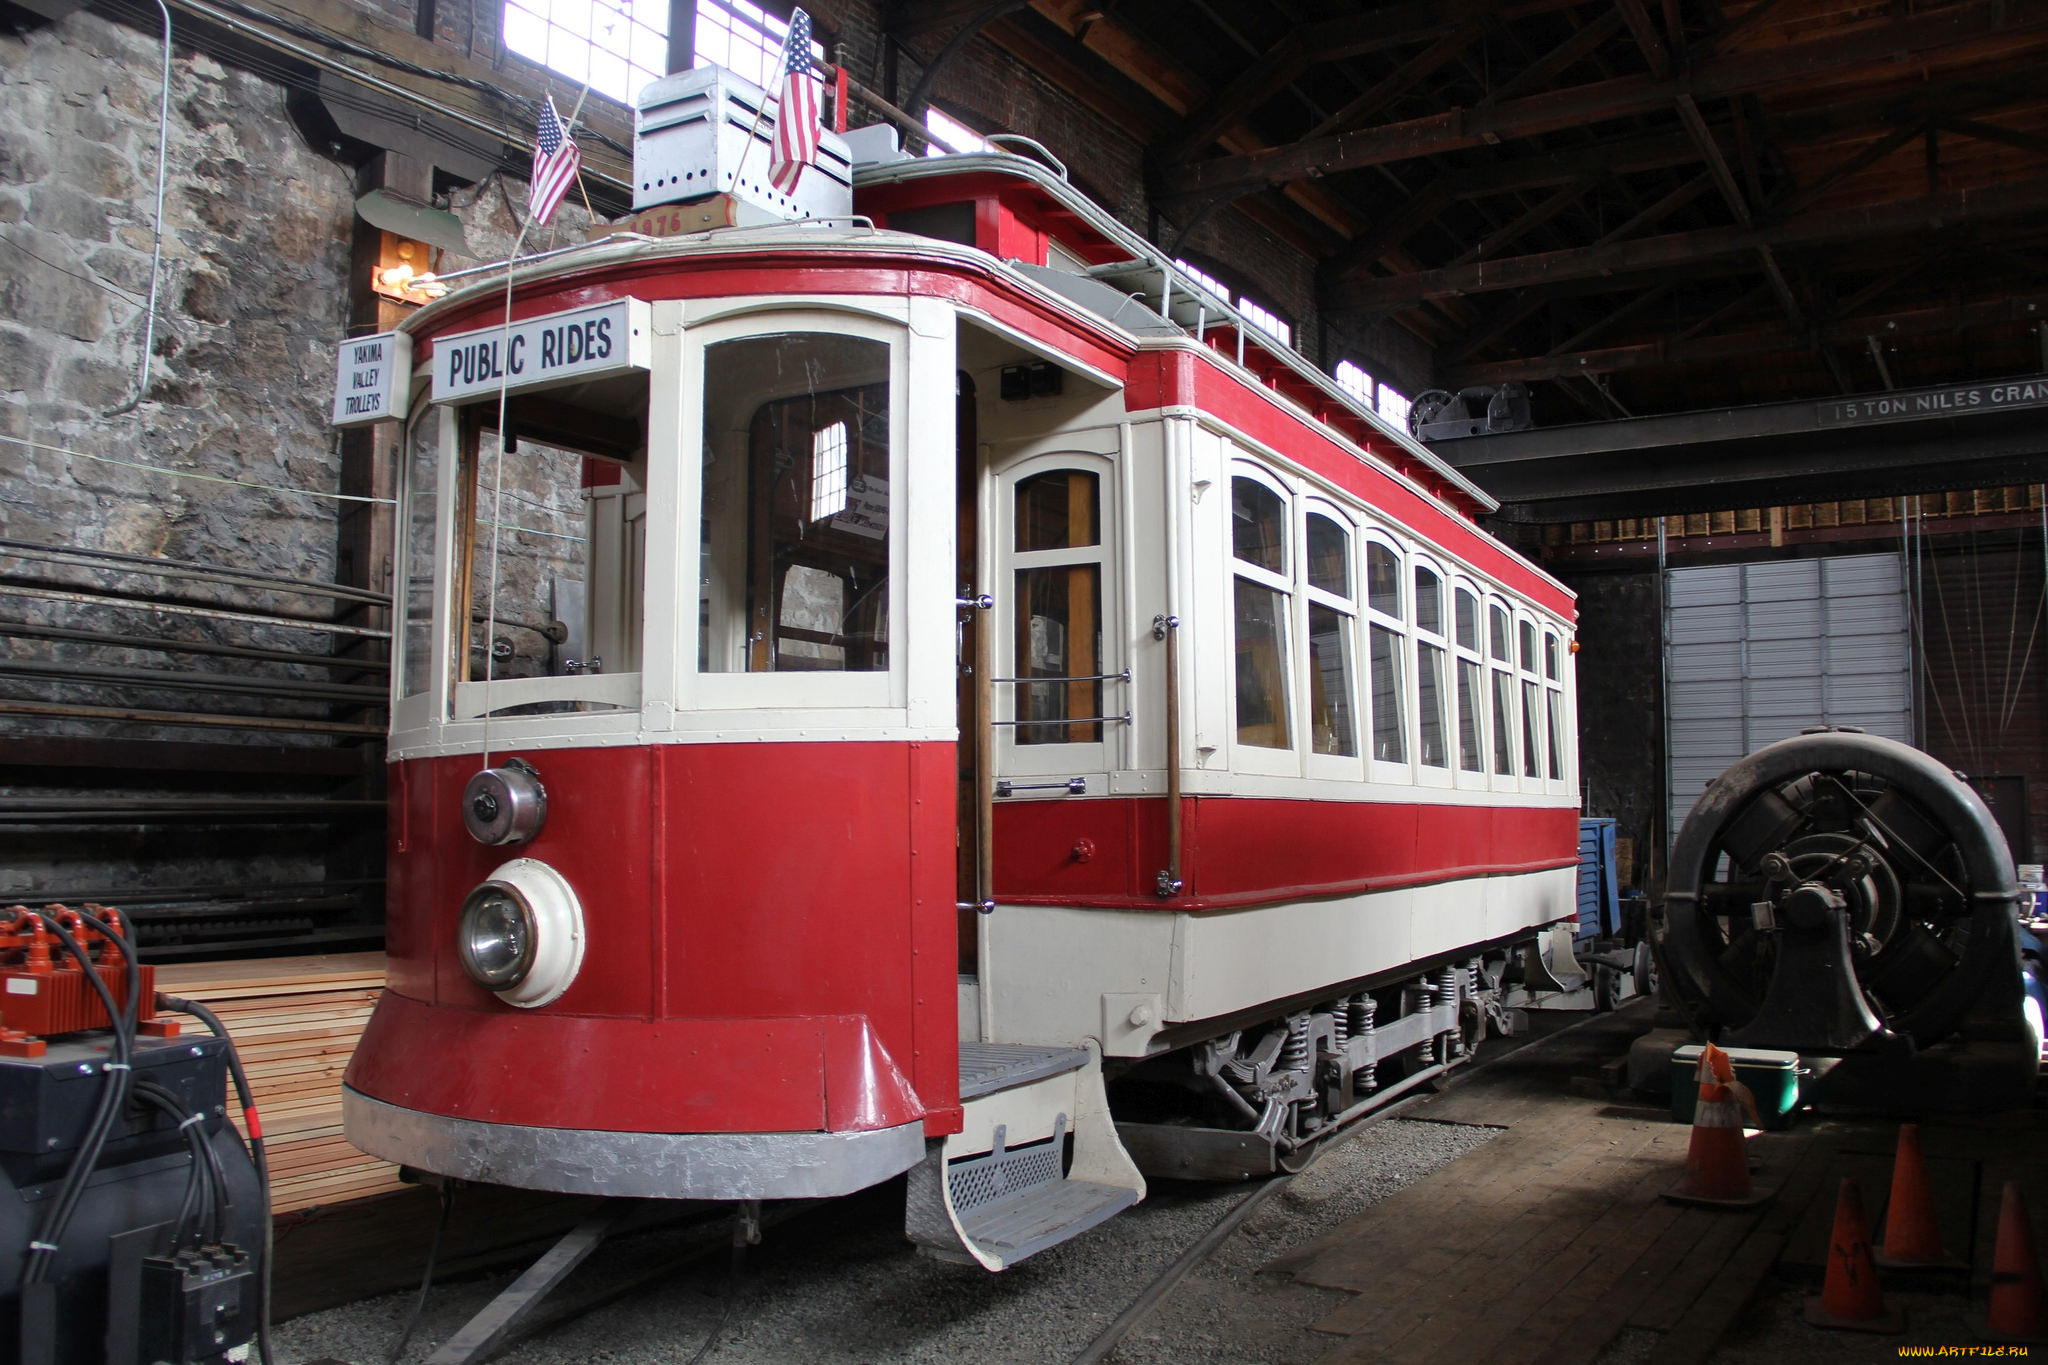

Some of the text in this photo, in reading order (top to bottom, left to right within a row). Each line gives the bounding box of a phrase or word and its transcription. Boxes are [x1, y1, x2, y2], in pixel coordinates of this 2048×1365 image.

[354, 343, 382, 365] YAKIMA
[541, 317, 612, 369] RIDES
[353, 368, 380, 389] VALLEY
[345, 393, 381, 415] TROLLEYS
[1835, 403, 1857, 420] 15
[1864, 400, 1907, 415] TON
[1917, 391, 1981, 410] NILES
